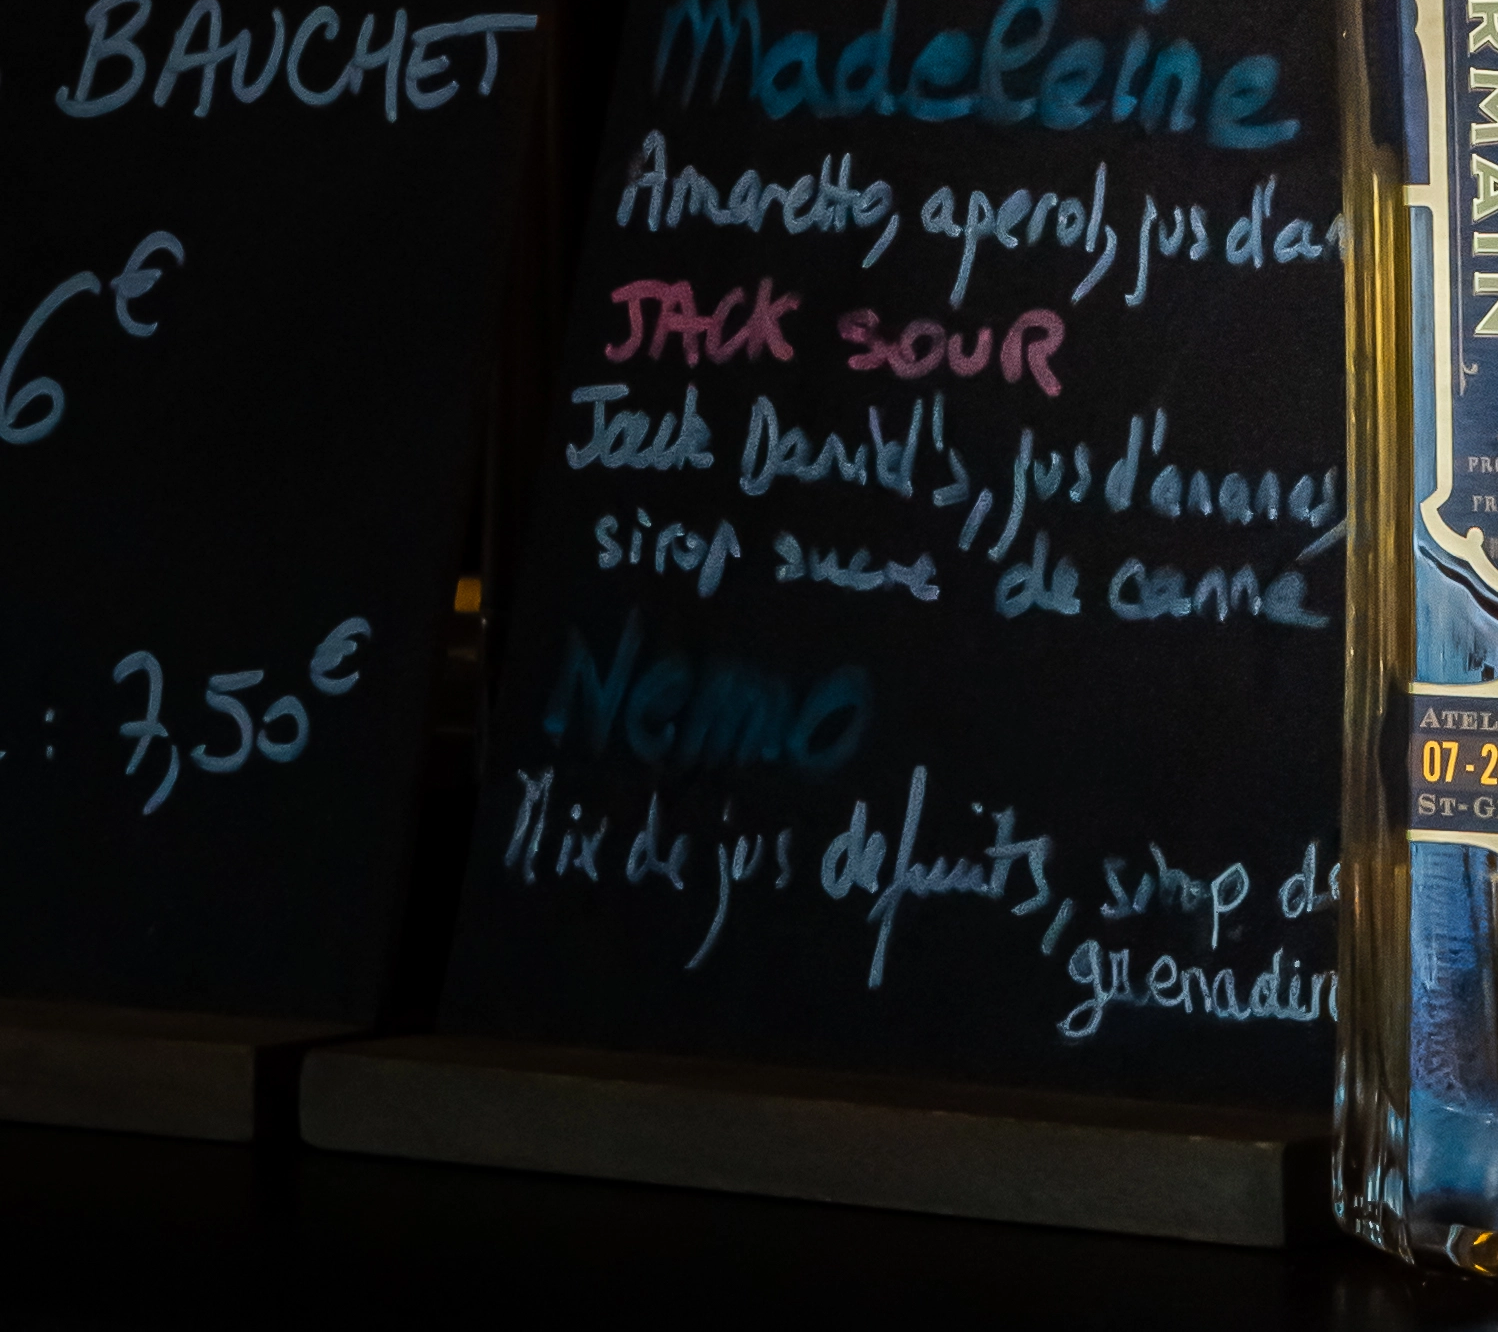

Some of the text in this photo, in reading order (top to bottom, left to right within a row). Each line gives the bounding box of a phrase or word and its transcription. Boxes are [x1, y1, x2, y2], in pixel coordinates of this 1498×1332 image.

[604, 277, 1067, 399] JACK SOUR
[567, 384, 714, 471] Jack
[595, 507, 741, 598] sirop
[543, 607, 871, 773] Nemo
